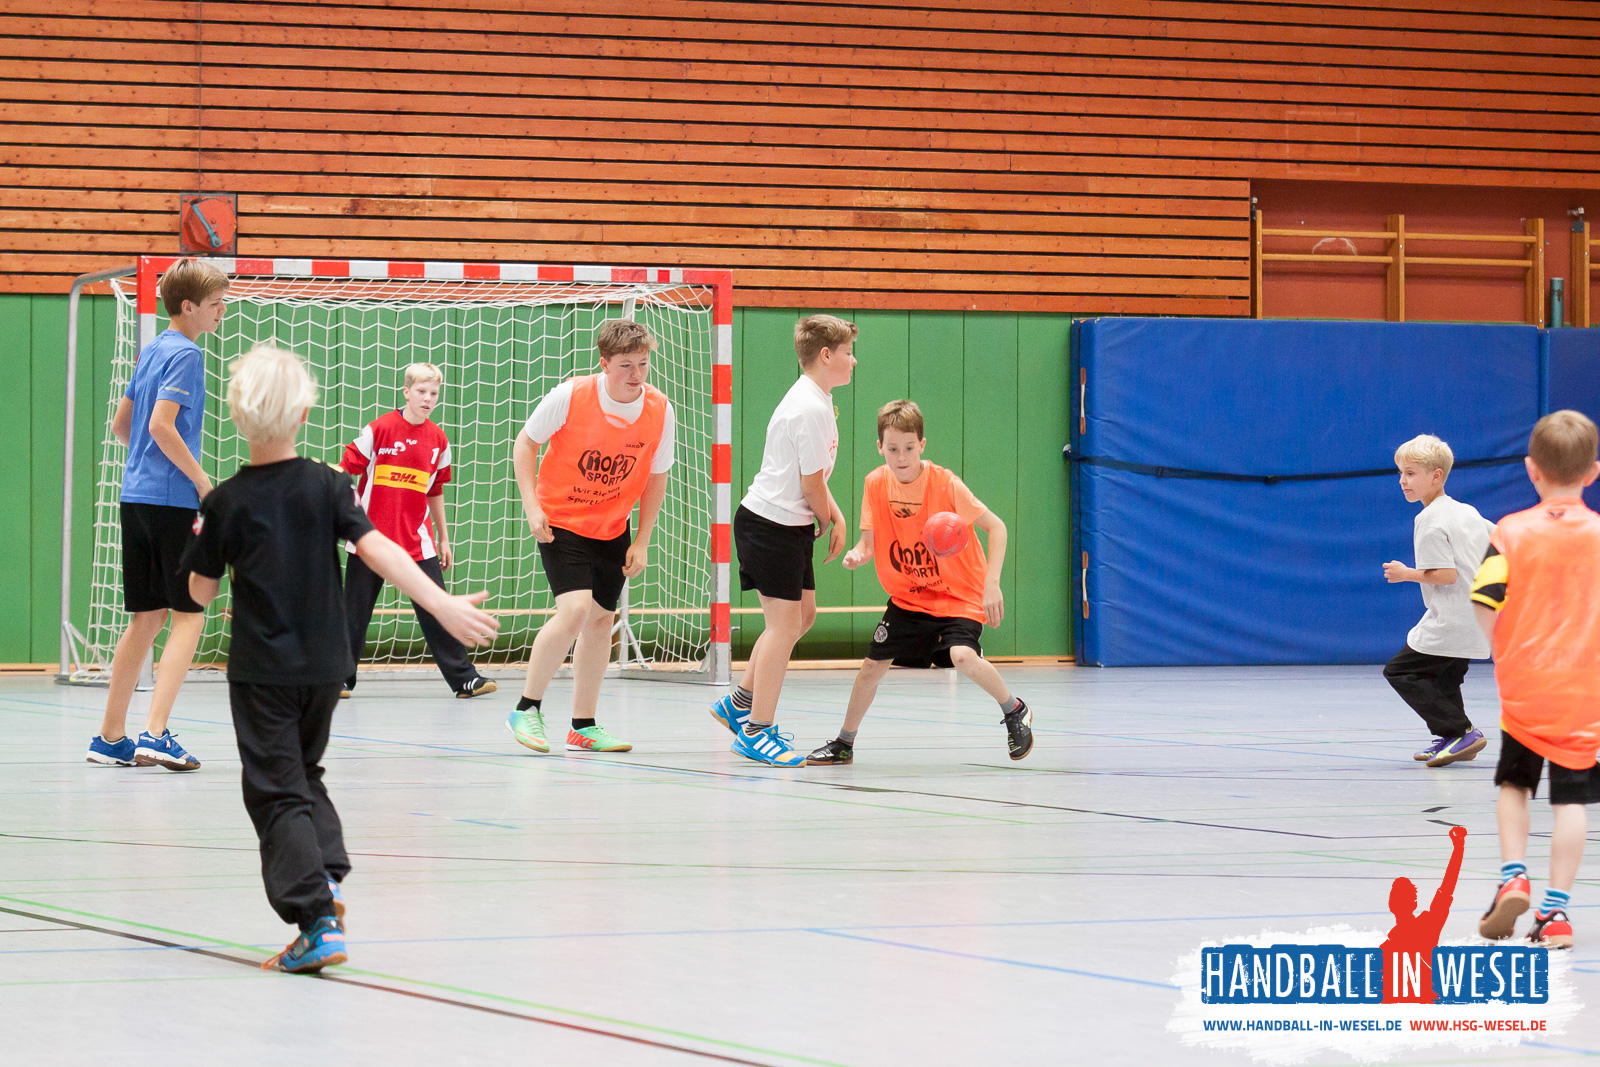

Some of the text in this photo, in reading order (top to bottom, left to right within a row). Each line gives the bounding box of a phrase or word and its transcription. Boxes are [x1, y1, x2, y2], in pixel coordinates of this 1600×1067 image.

[378, 447, 398, 456] RWE
[430, 447, 440, 465] 1
[390, 471, 418, 484] DHL
[587, 472, 621, 486] SPORT
[573, 485, 591, 494] Wir
[566, 728, 597, 748] NIKE
